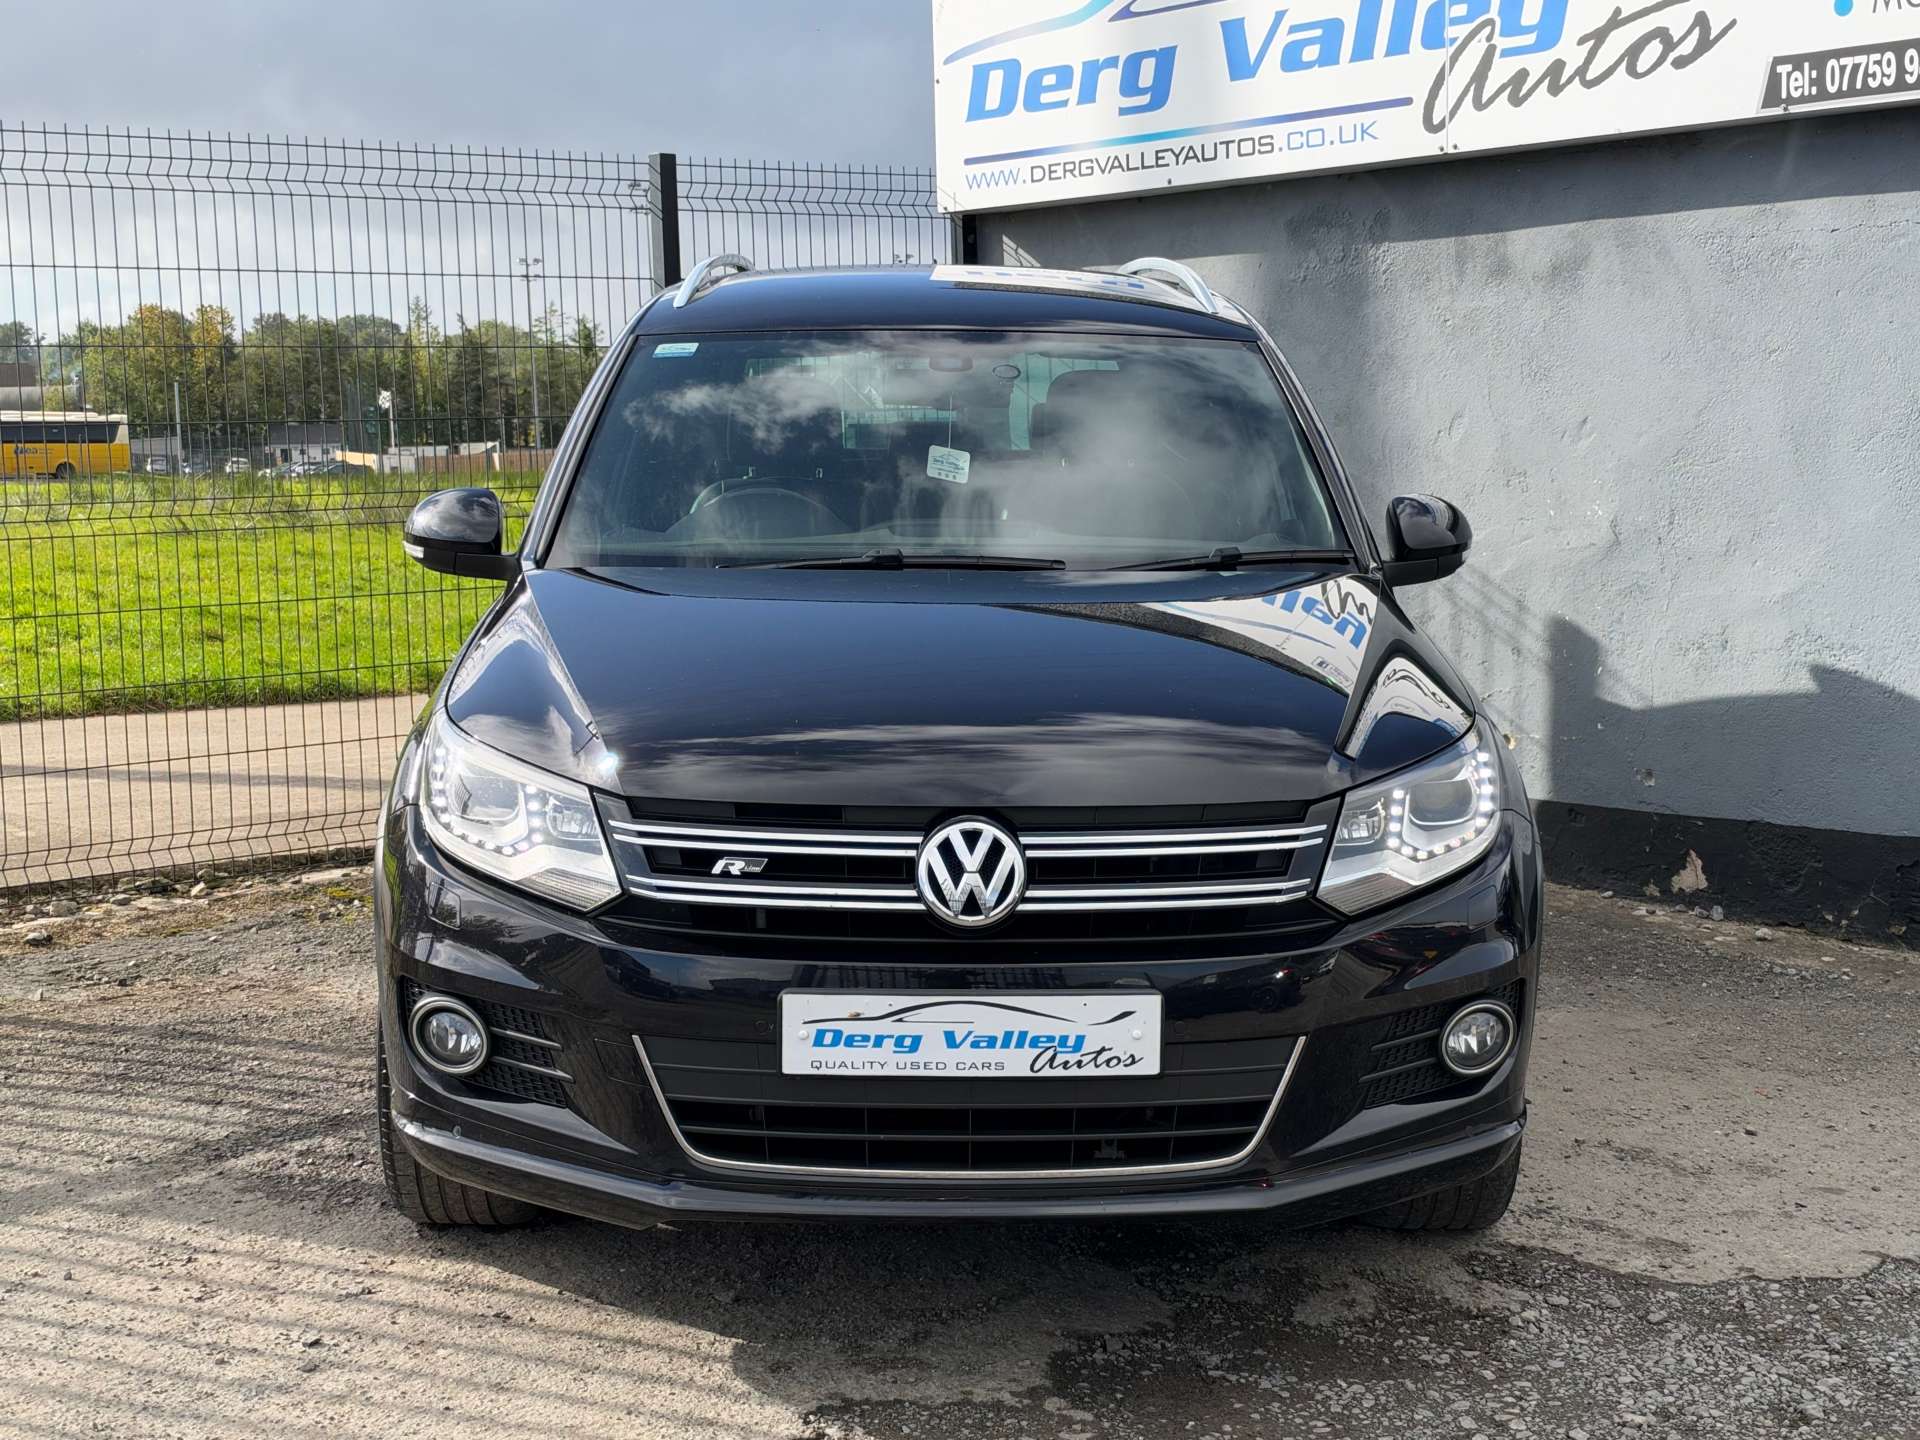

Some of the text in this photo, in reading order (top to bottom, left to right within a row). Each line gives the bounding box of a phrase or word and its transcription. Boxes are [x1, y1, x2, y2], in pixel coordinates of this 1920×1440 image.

[966, 0, 1738, 134] Derg Valley Autos
[1776, 48, 1920, 100] Tel: 07759 9
[964, 120, 1379, 191] WWW.DERGVALLEYAUTOS.CO.UK
[810, 1060, 1005, 1071] QUALITY USED CARS
[811, 1027, 924, 1055] Derg
[942, 1029, 1087, 1055] Valley
